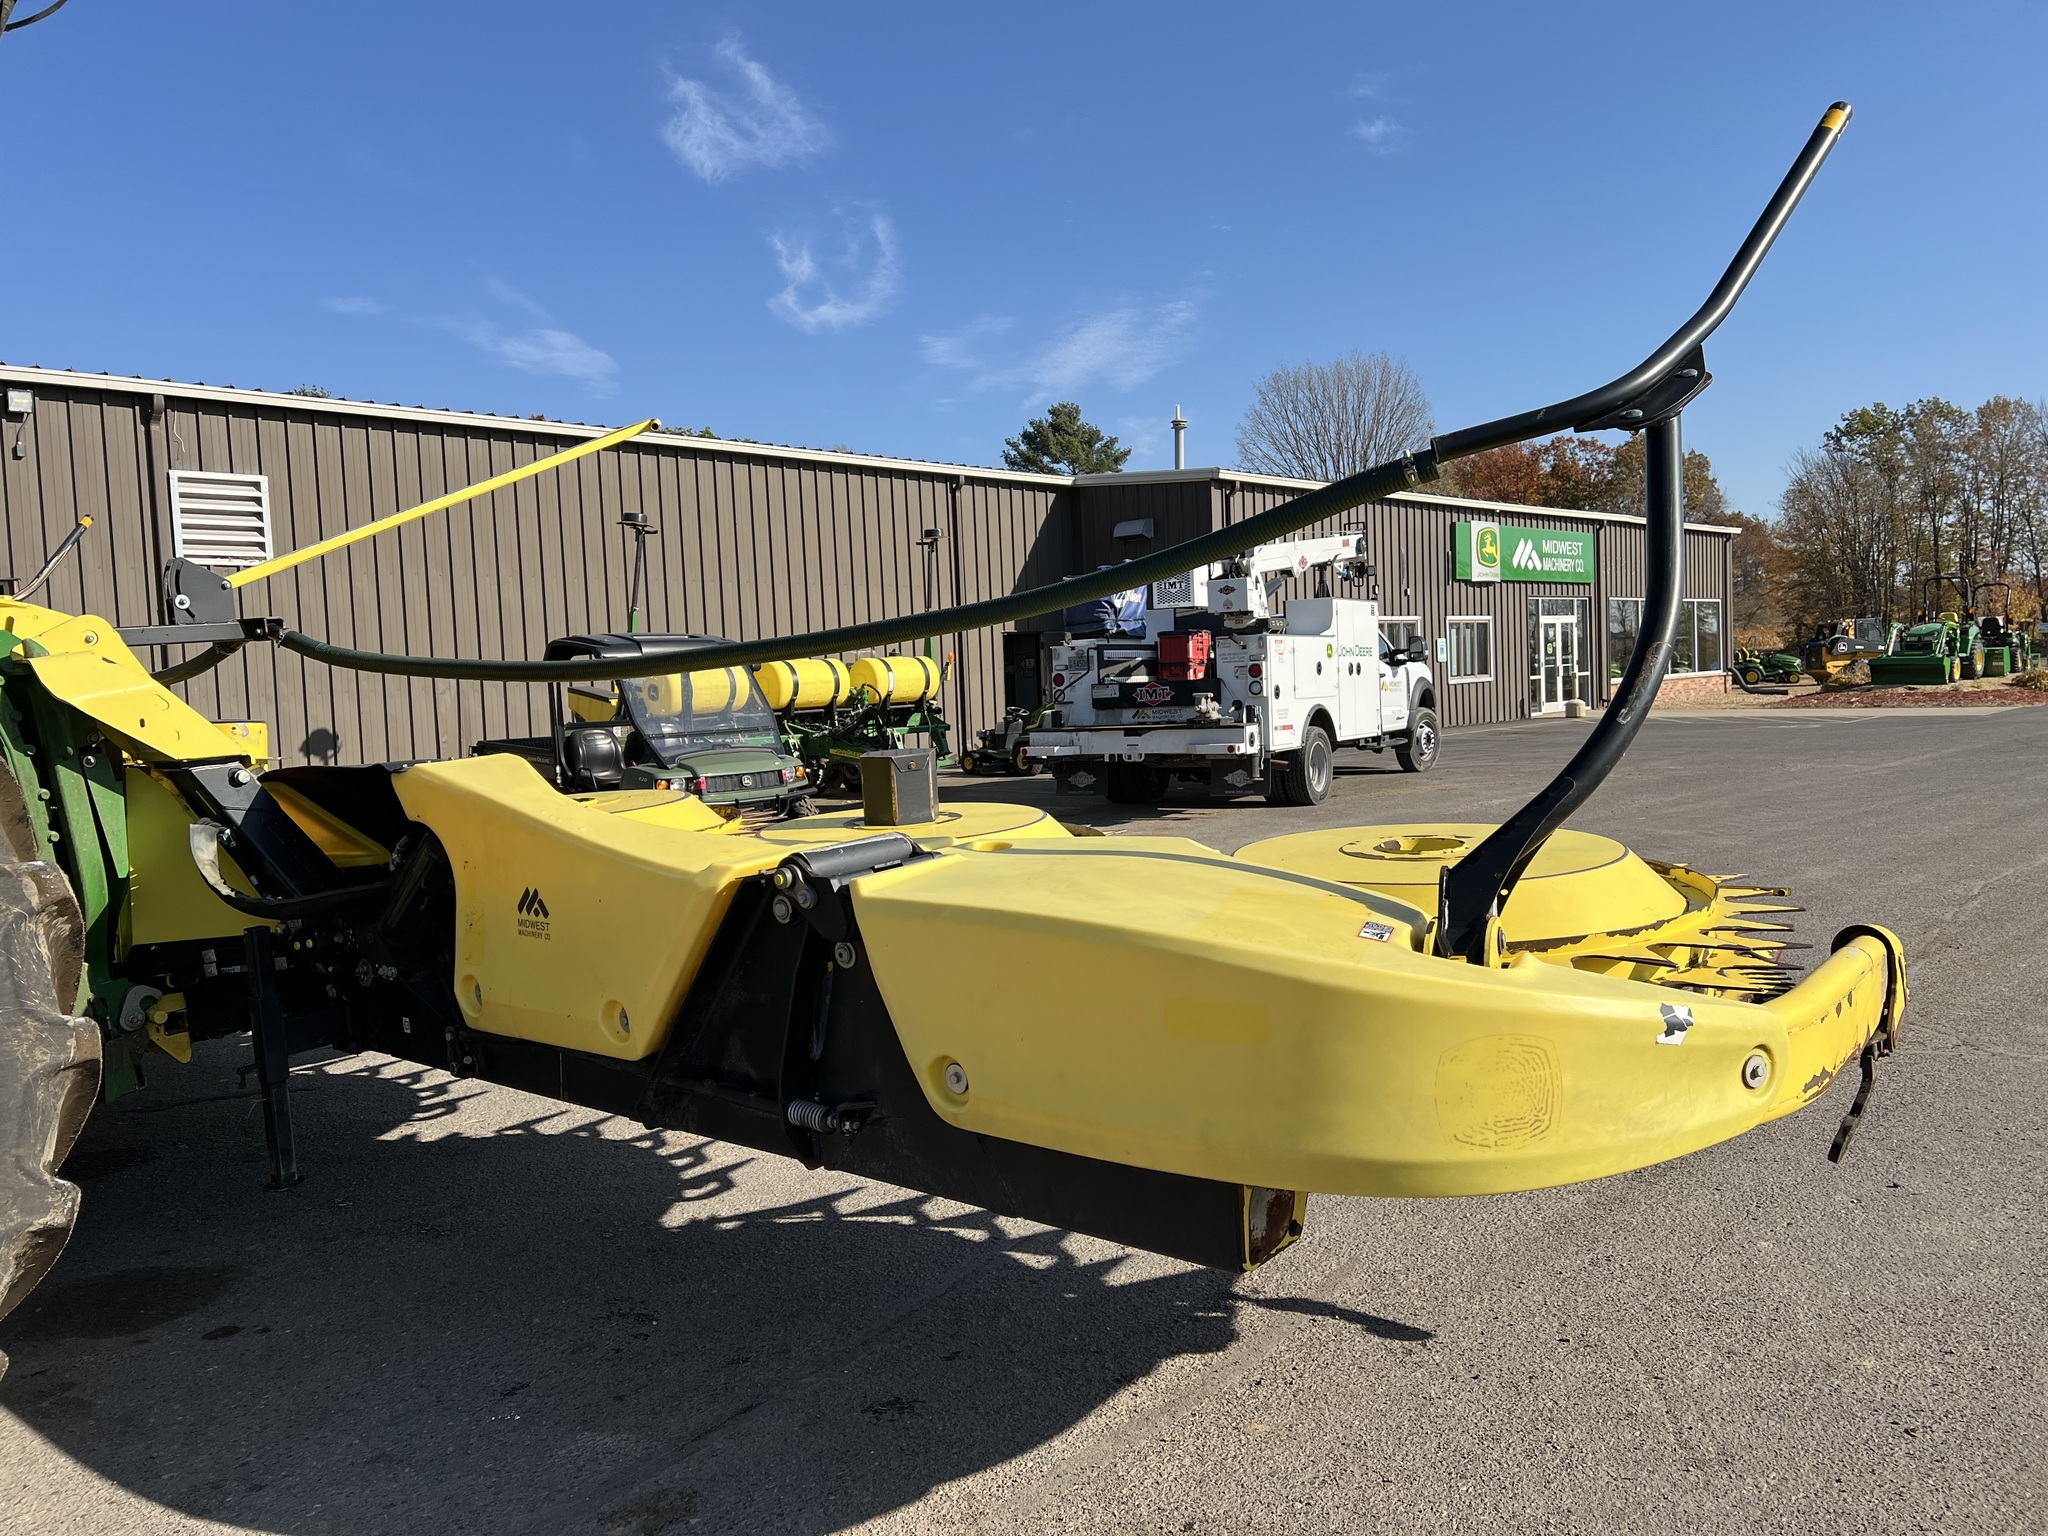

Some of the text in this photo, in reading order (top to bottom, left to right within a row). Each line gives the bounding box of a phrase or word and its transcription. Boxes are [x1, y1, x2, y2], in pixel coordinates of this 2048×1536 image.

[1542, 539, 1583, 555] MIDWEST
[1542, 557, 1585, 573] MACHINERY CO.
[1163, 580, 1185, 590] IMT
[1338, 644, 1373, 657] JOHN DEERE
[1138, 687, 1169, 701] IMT
[517, 918, 550, 931] MIDWEST
[517, 929, 543, 939] MACHINERY
